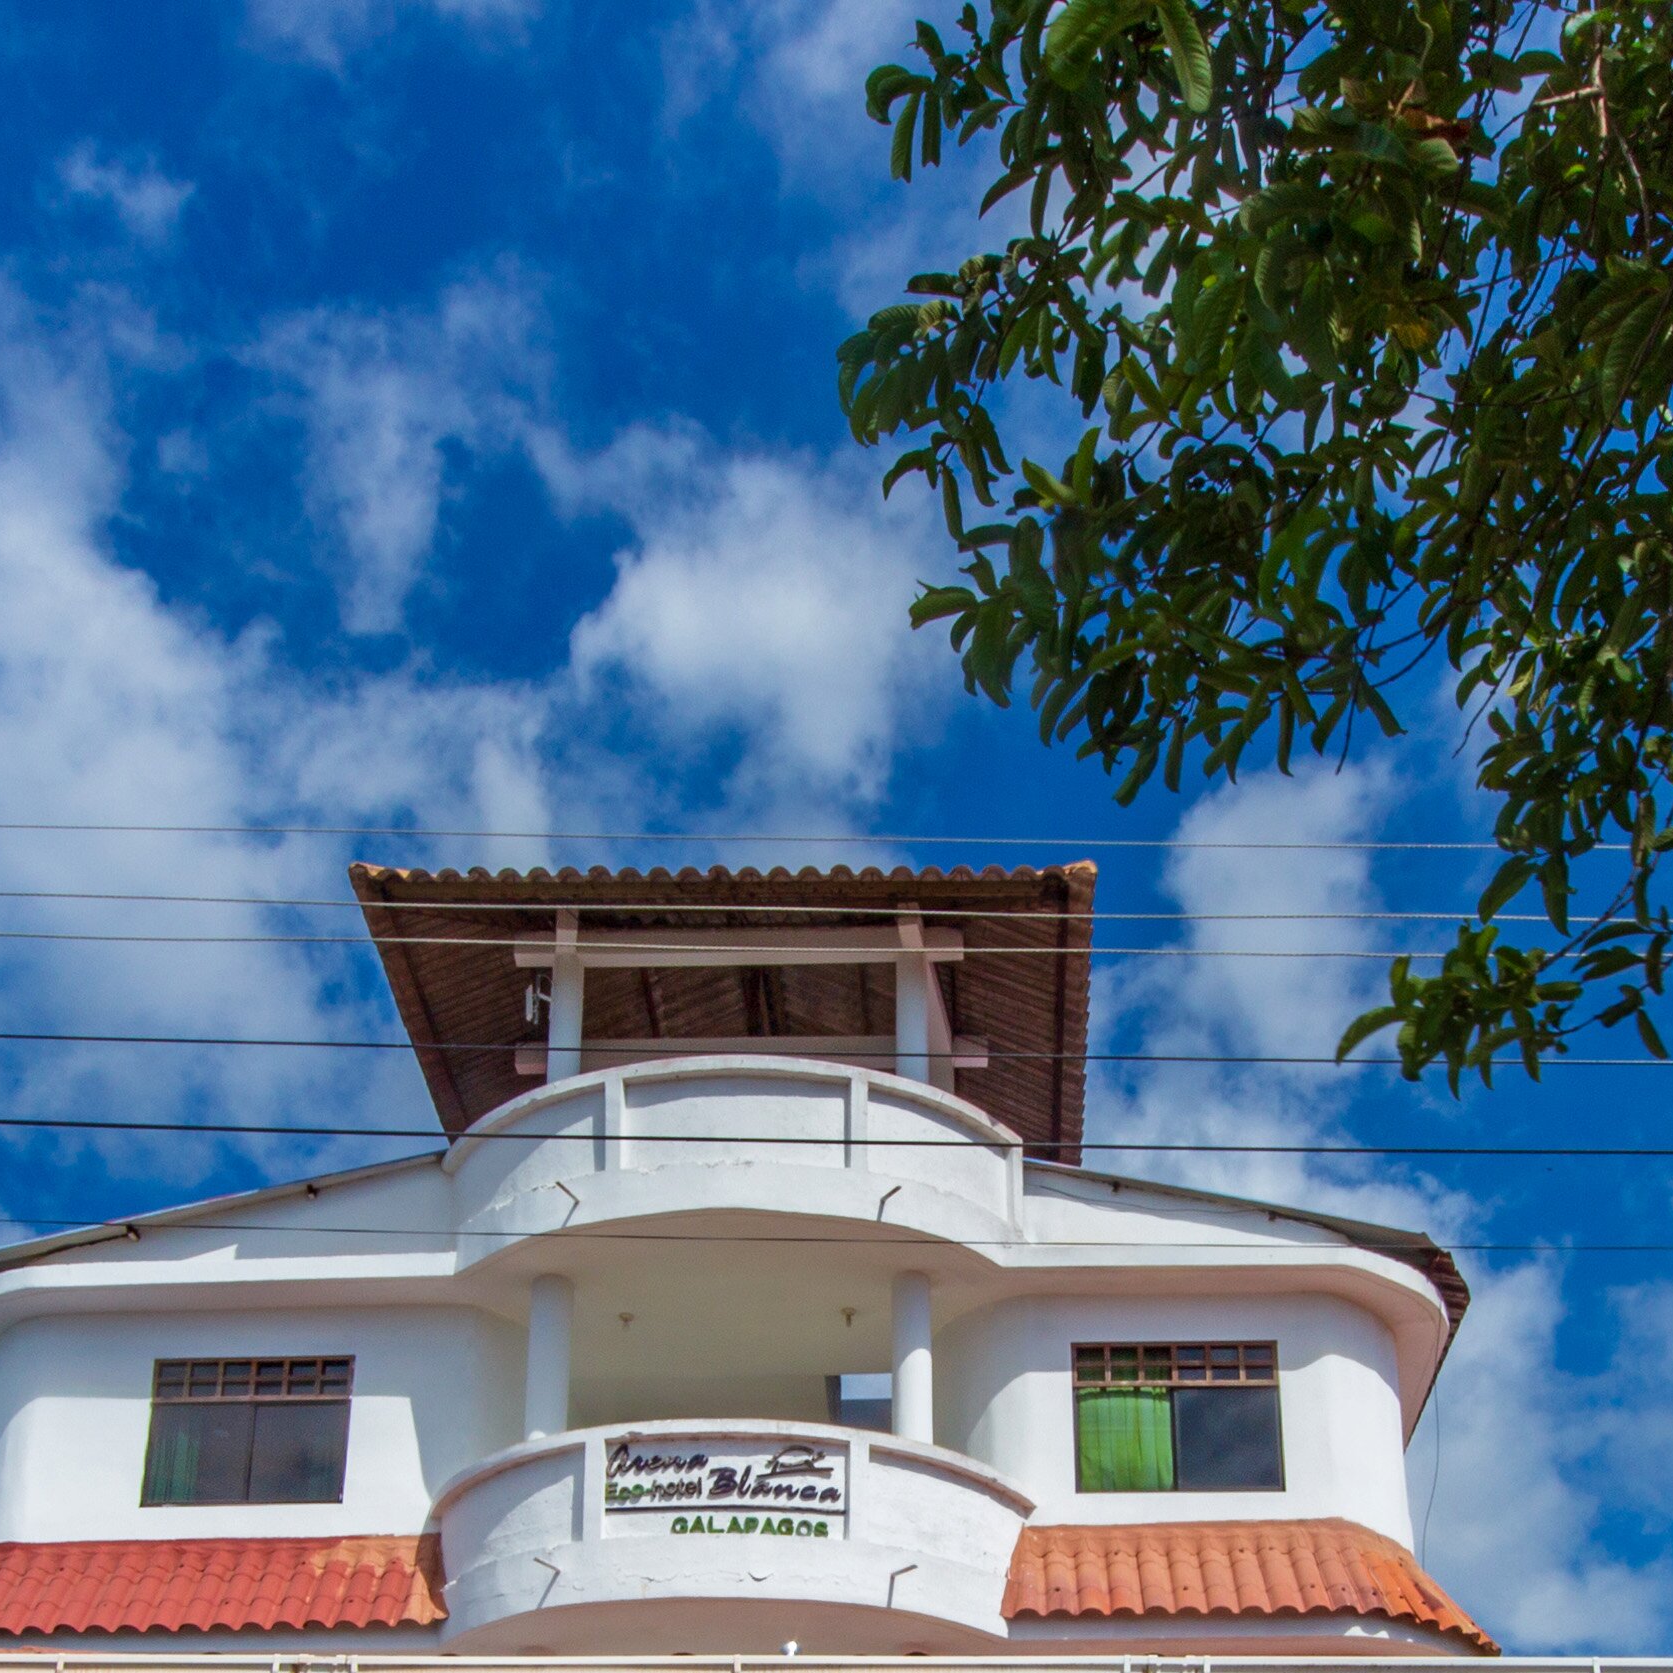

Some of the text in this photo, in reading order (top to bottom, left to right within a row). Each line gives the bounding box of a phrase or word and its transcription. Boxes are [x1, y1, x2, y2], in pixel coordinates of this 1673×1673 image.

[607, 1443, 709, 1476] Arena
[707, 1467, 842, 1502] Blanca
[671, 1516, 829, 1537] GALAPAGOS
